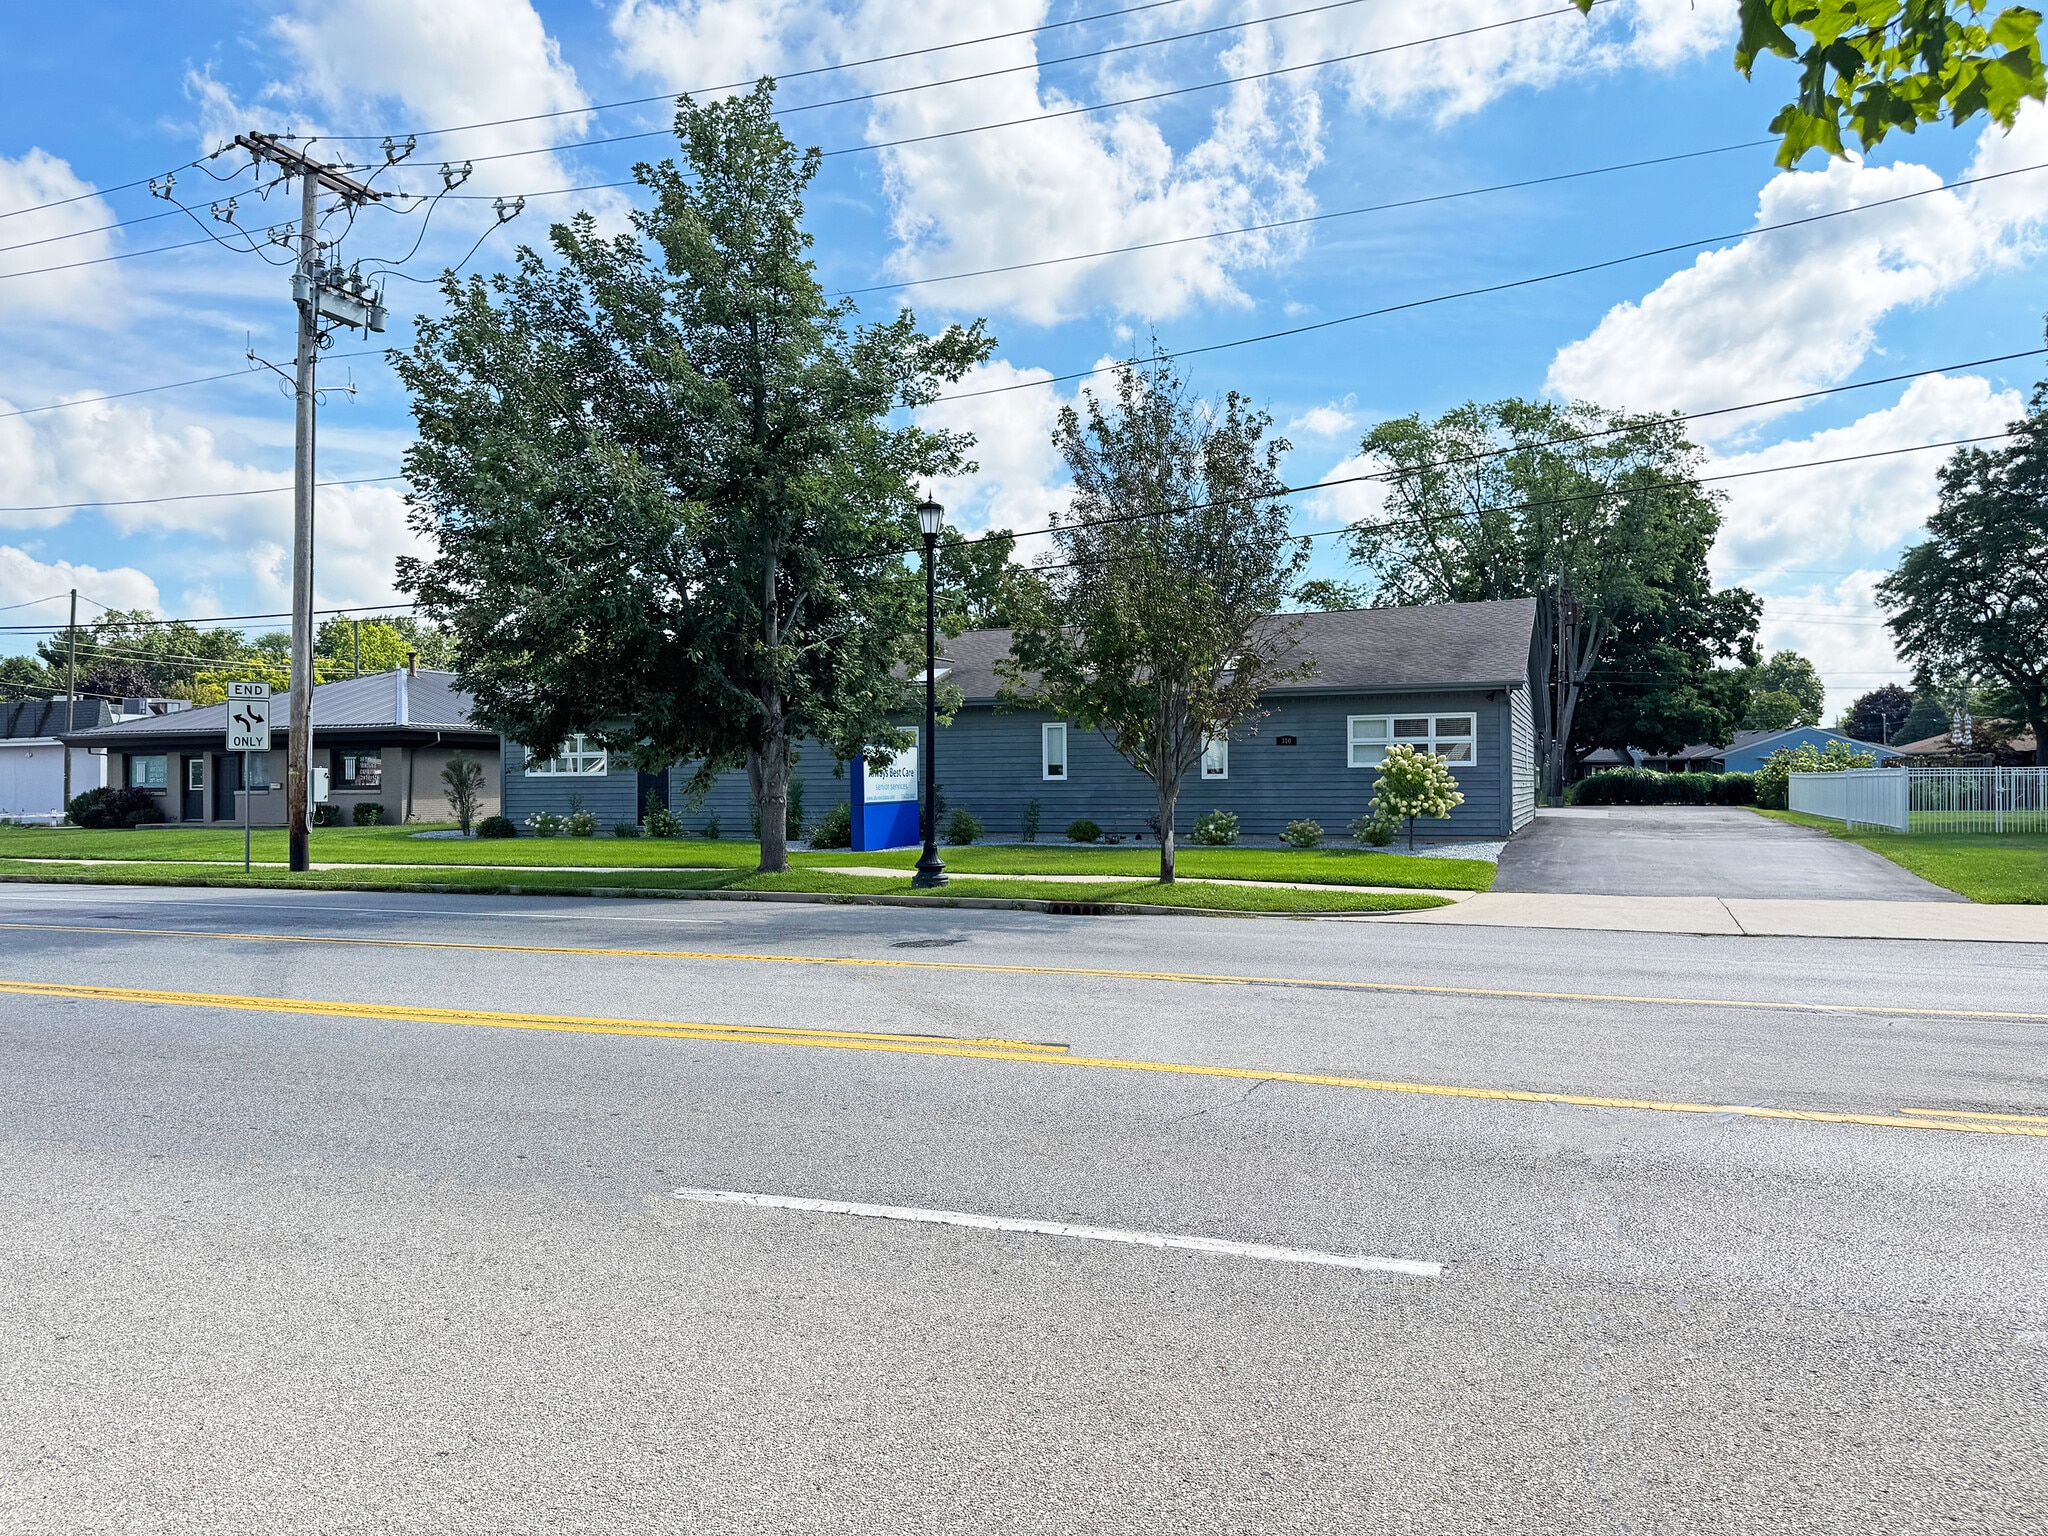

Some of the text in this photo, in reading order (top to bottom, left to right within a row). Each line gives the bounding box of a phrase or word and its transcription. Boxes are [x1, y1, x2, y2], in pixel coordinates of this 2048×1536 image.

[235, 685, 263, 695] END
[233, 736, 263, 746] ONLY
[890, 768, 902, 778] Best
[902, 768, 915, 777] Care
